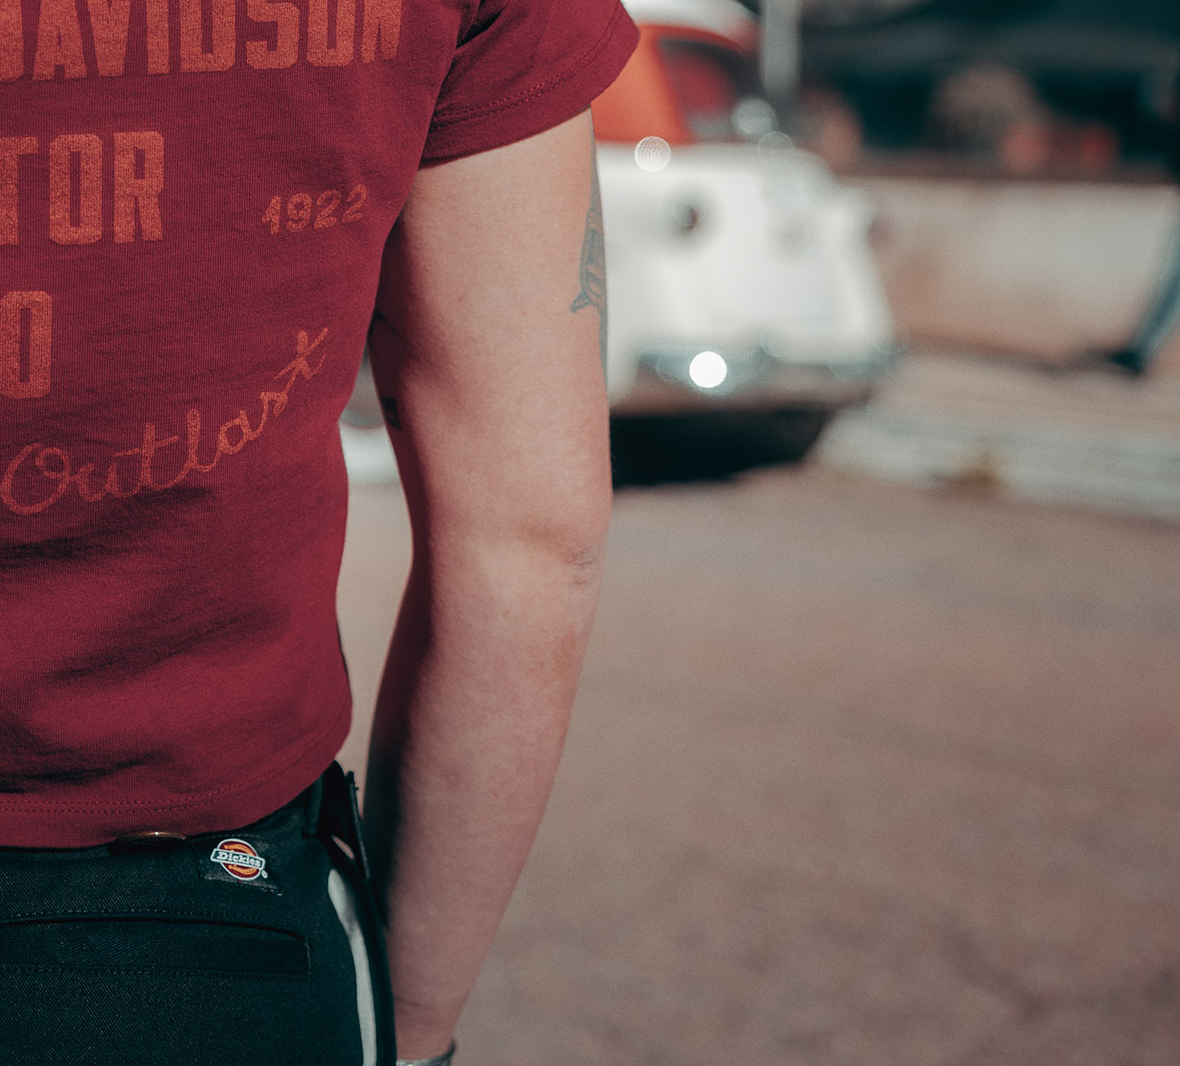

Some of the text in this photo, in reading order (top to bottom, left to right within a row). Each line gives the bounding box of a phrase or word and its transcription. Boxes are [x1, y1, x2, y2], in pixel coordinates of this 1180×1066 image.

[261, 184, 367, 236] 1922
[1, 327, 328, 516] Outlast
[215, 851, 262, 868] Dickies
